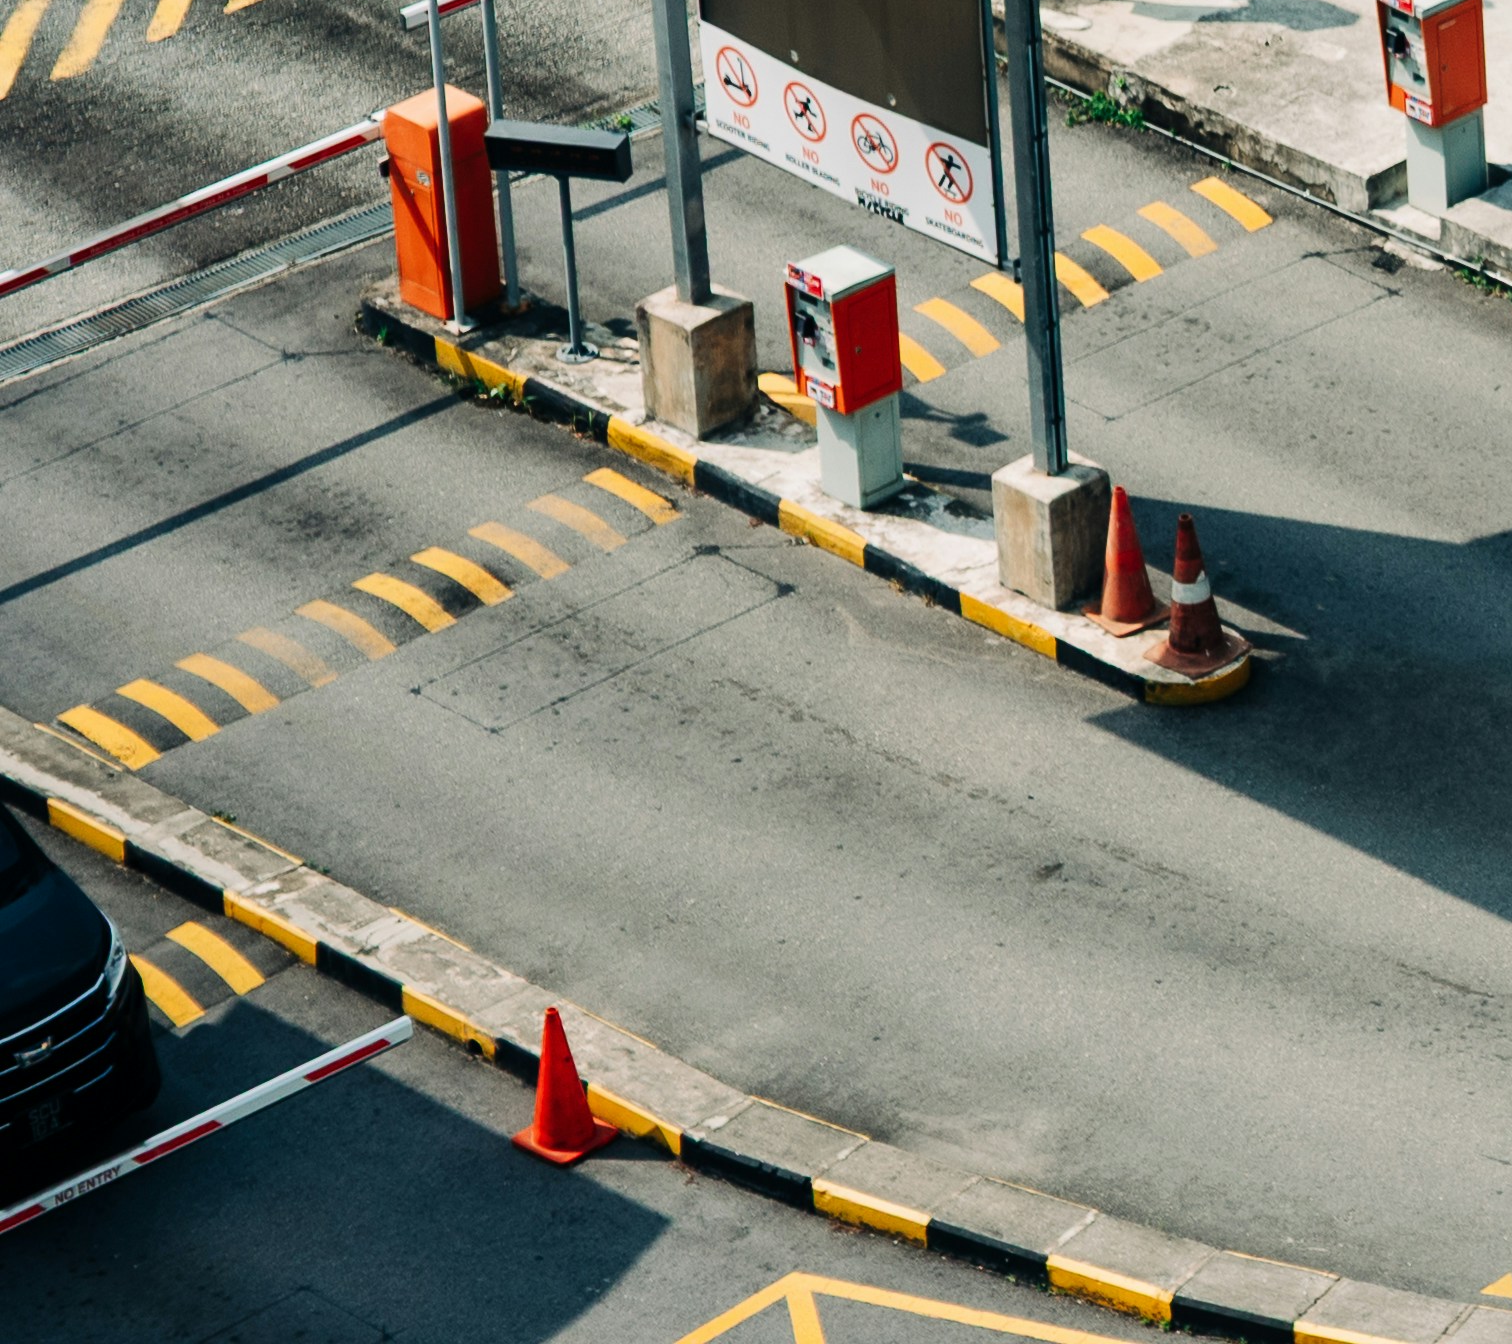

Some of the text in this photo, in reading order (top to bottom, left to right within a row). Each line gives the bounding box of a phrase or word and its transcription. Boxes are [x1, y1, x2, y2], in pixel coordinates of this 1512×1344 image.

[733, 111, 751, 130] NO
[802, 146, 819, 164] NO
[870, 178, 890, 197] NO
[944, 208, 963, 227] NO
[54, 1166, 121, 1205] NO ENTRY
